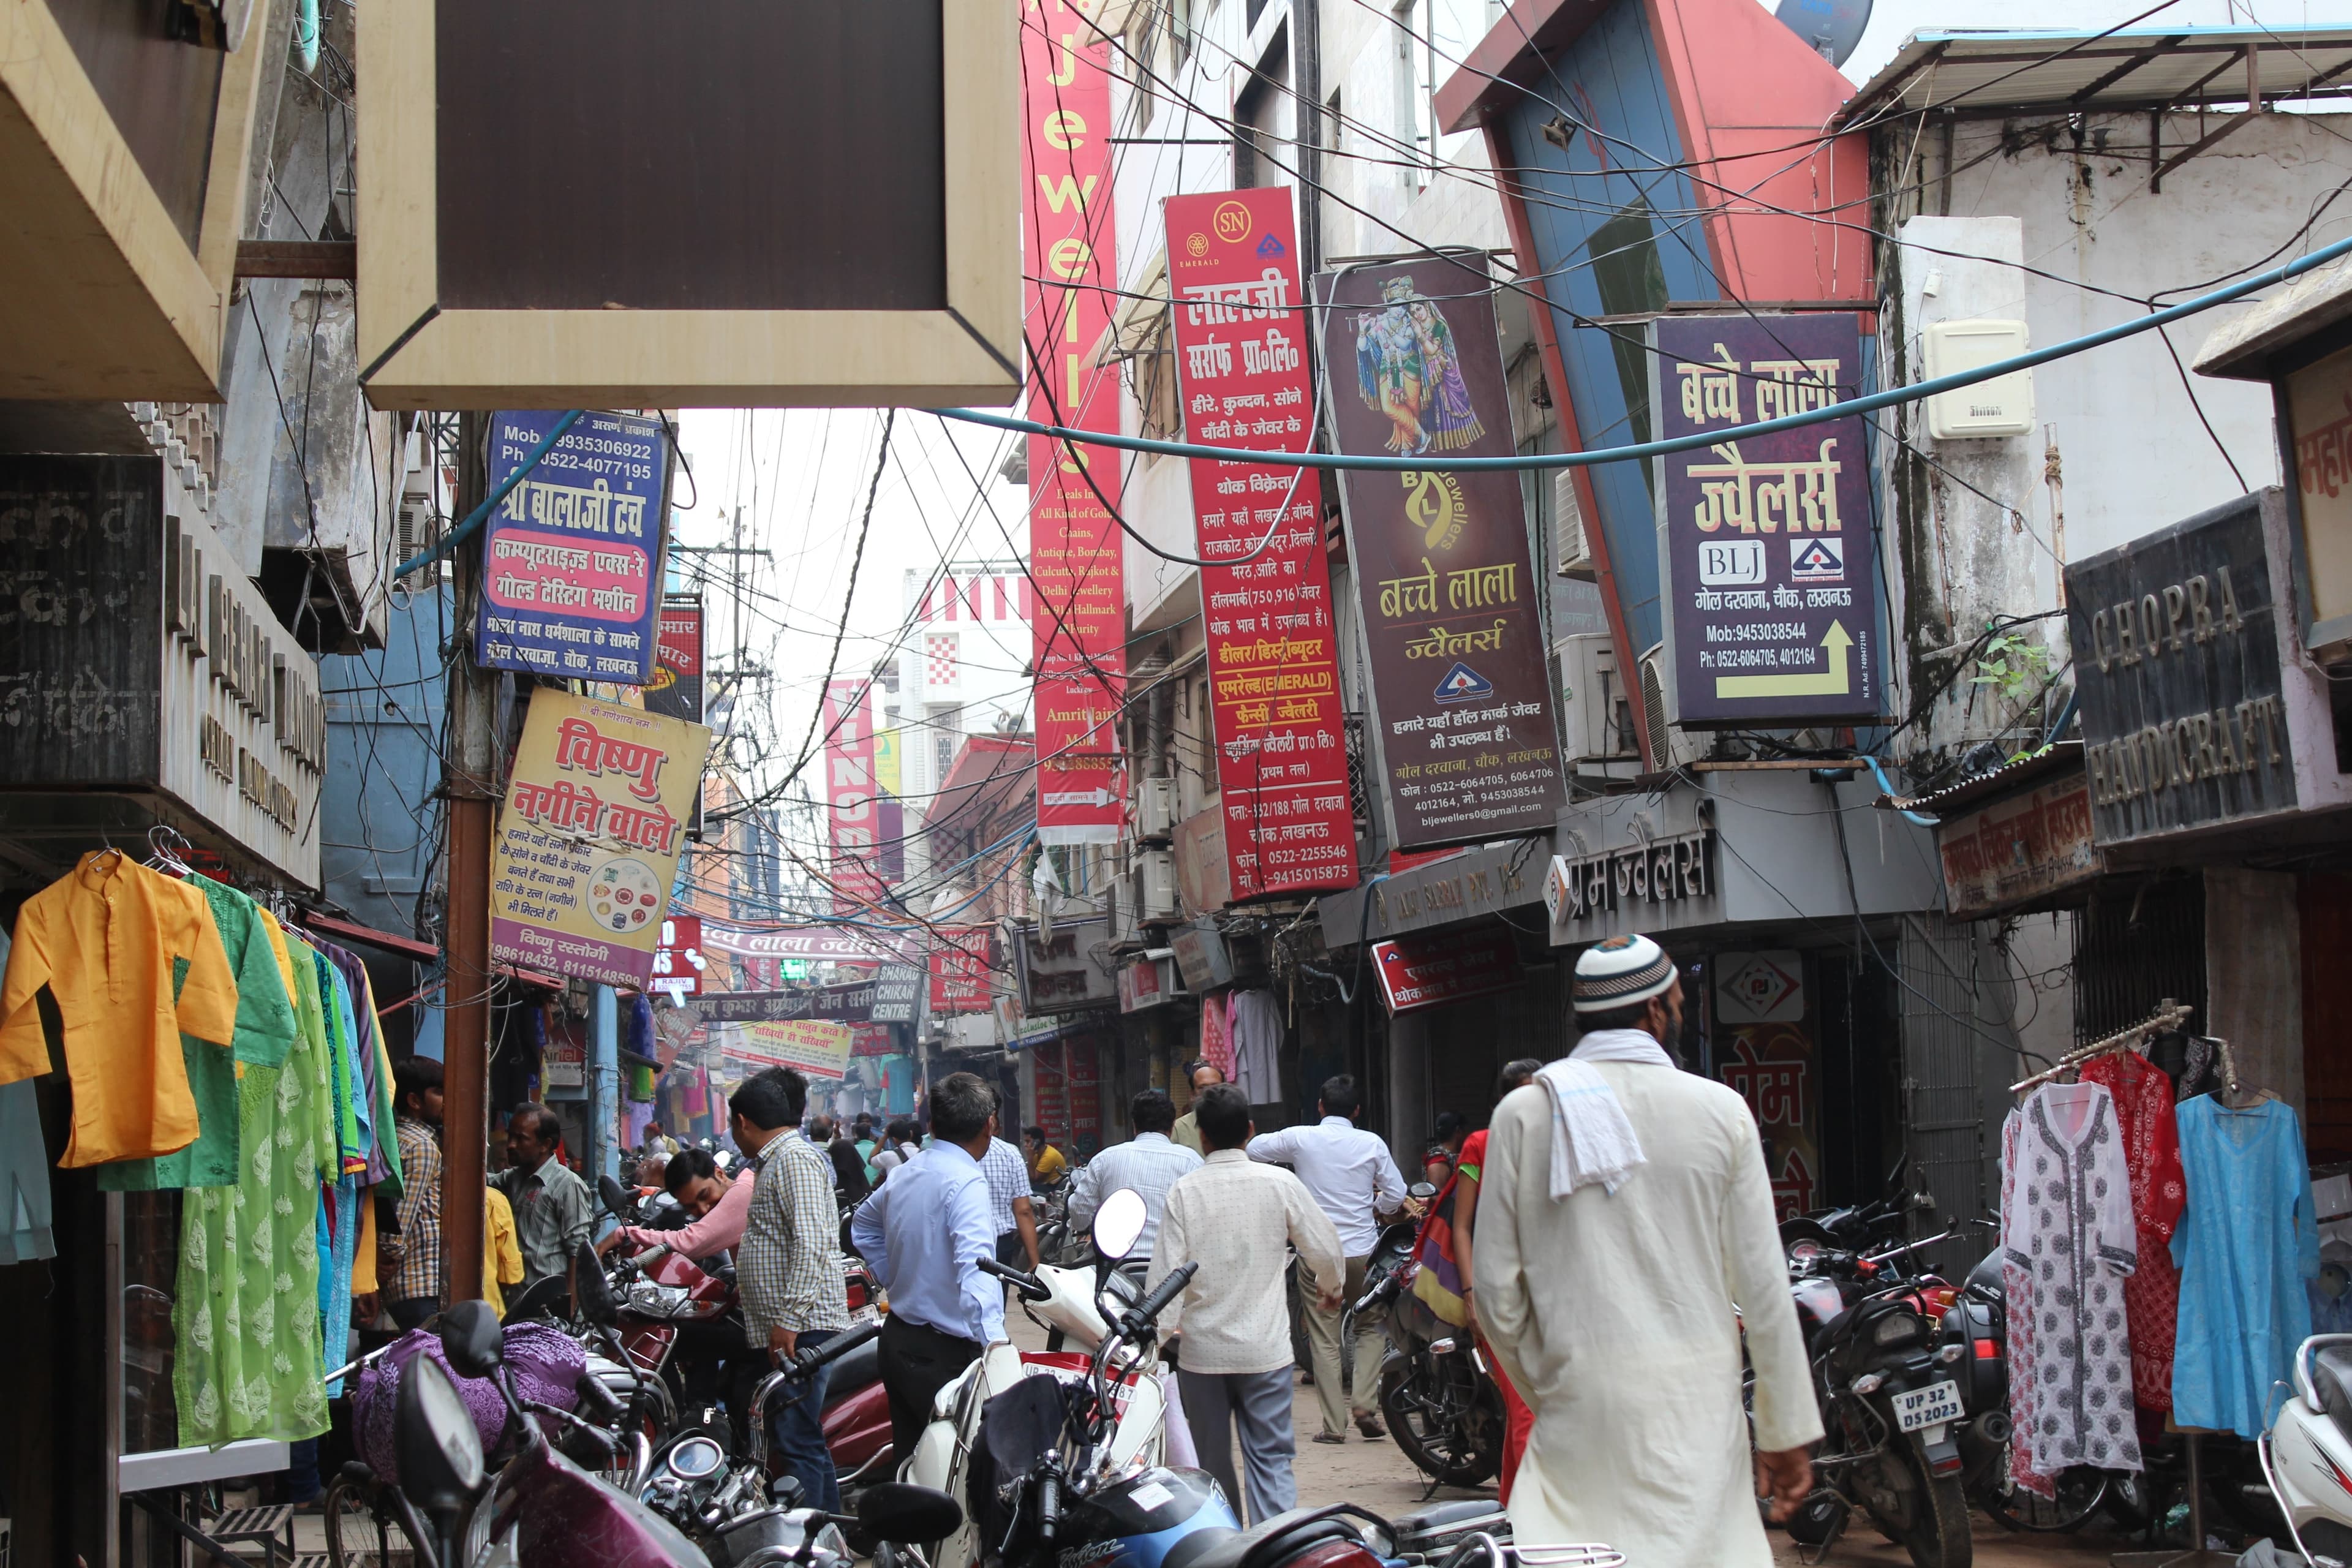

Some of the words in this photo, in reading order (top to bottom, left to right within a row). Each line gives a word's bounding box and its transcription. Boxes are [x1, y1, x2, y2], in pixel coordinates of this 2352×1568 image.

[1220, 211, 1245, 233] SN
[1180, 259, 1219, 268] EMERALD
[1183, 267, 1289, 326] लालजी
[1676, 342, 1741, 424] बच्चे
[1751, 358, 1841, 423] लाला
[1191, 394, 1219, 414] हीरे,
[1223, 394, 1270, 417] कुन्दन,
[1273, 386, 1302, 405] सोने
[1200, 420, 1231, 440] चाँदी
[1234, 419, 1248, 437] के
[1251, 418, 1284, 435] जेवर
[1286, 415, 1302, 432] के
[1085, 489, 1094, 499] In
[1217, 477, 1246, 495] थोक
[530, 478, 613, 532] बालाजी
[1039, 508, 1052, 519] All
[1079, 507, 1089, 519] of
[1202, 508, 1226, 529] हमारे
[1231, 506, 1249, 526] यहाँ
[1110, 567, 1119, 576] &
[1283, 560, 1296, 575] का
[496, 571, 536, 599] गोल्ड
[592, 585, 638, 614] मशीन
[1042, 585, 1067, 595] Delhi
[1378, 557, 1439, 618] बच्चे
[1447, 562, 1518, 611] लाला
[1695, 587, 1722, 611] गोल
[1724, 590, 1770, 611] दरवाजा,
[1773, 583, 1804, 610] चौक,
[1806, 587, 1852, 608] लखनऊ
[1074, 603, 1116, 615] Hallmark
[2092, 565, 2245, 674] CHOPRA
[519, 620, 542, 638] नाथ
[545, 622, 591, 644] धर्मशाला
[593, 627, 606, 645] के
[609, 631, 641, 650] सामने
[1210, 616, 1230, 636] थोक
[1236, 618, 1255, 633] भाव
[1706, 622, 1807, 643] Mob:9453038544
[597, 657, 638, 676] लखनऊ
[1700, 650, 1715, 668] Ph:
[1717, 649, 1778, 668] 0522-6064705,
[1780, 647, 1815, 665] 4012164
[589, 706, 600, 717] श्री
[602, 710, 633, 724] गणेशाय
[1046, 707, 1087, 722] Amrit
[1392, 715, 1425, 735] हमारे
[1427, 710, 1450, 729] यहाँ
[1452, 709, 1479, 726] हॉल
[1511, 701, 1542, 717] जेवर
[1430, 736, 1445, 750] भी
[1449, 730, 1492, 747] उपलब्ध
[2087, 693, 2283, 806] HANDICRAFT
[554, 717, 669, 804] विष्णु
[1289, 760, 1310, 778] तल)
[1395, 763, 1421, 780] गोल
[1430, 774, 1507, 794] 0522-6064705,
[1510, 768, 1554, 783] 6064706
[1400, 783, 1421, 798] फोन
[1415, 797, 1460, 812] 4012164,
[1480, 784, 1545, 803] 9453038544
[1314, 795, 1344, 813] दरवाजा
[1421, 802, 1542, 827] bljewellers0@gmail.com
[513, 779, 609, 839] नगीने
[608, 802, 681, 857] वाले
[508, 829, 530, 842] हमारे
[500, 843, 509, 854] के
[511, 846, 529, 860] सोने
[531, 853, 538, 862] व
[540, 853, 558, 867] चाँदी
[559, 858, 570, 869] के
[571, 860, 592, 875] जेवर
[1268, 844, 1348, 864] 0522-2255546
[508, 865, 528, 878] बनते
[538, 873, 555, 884] तथा
[556, 876, 575, 889] सभी
[496, 879, 514, 892] राशि
[515, 883, 526, 895] के
[527, 888, 543, 900] रत्न
[545, 889, 578, 911] (नगीने)
[508, 899, 519, 912] भी
[520, 902, 545, 918] मिलते
[519, 929, 555, 954] विष्णु
[557, 940, 609, 962] रस्तोगी
[880, 963, 918, 980] SHARAD
[876, 984, 915, 999] CHIKAN
[1395, 986, 1422, 1002] थोक
[873, 1003, 911, 1019] CENTRE
[1905, 1393, 1924, 1410] UP
[1929, 1388, 1946, 1403] 32
